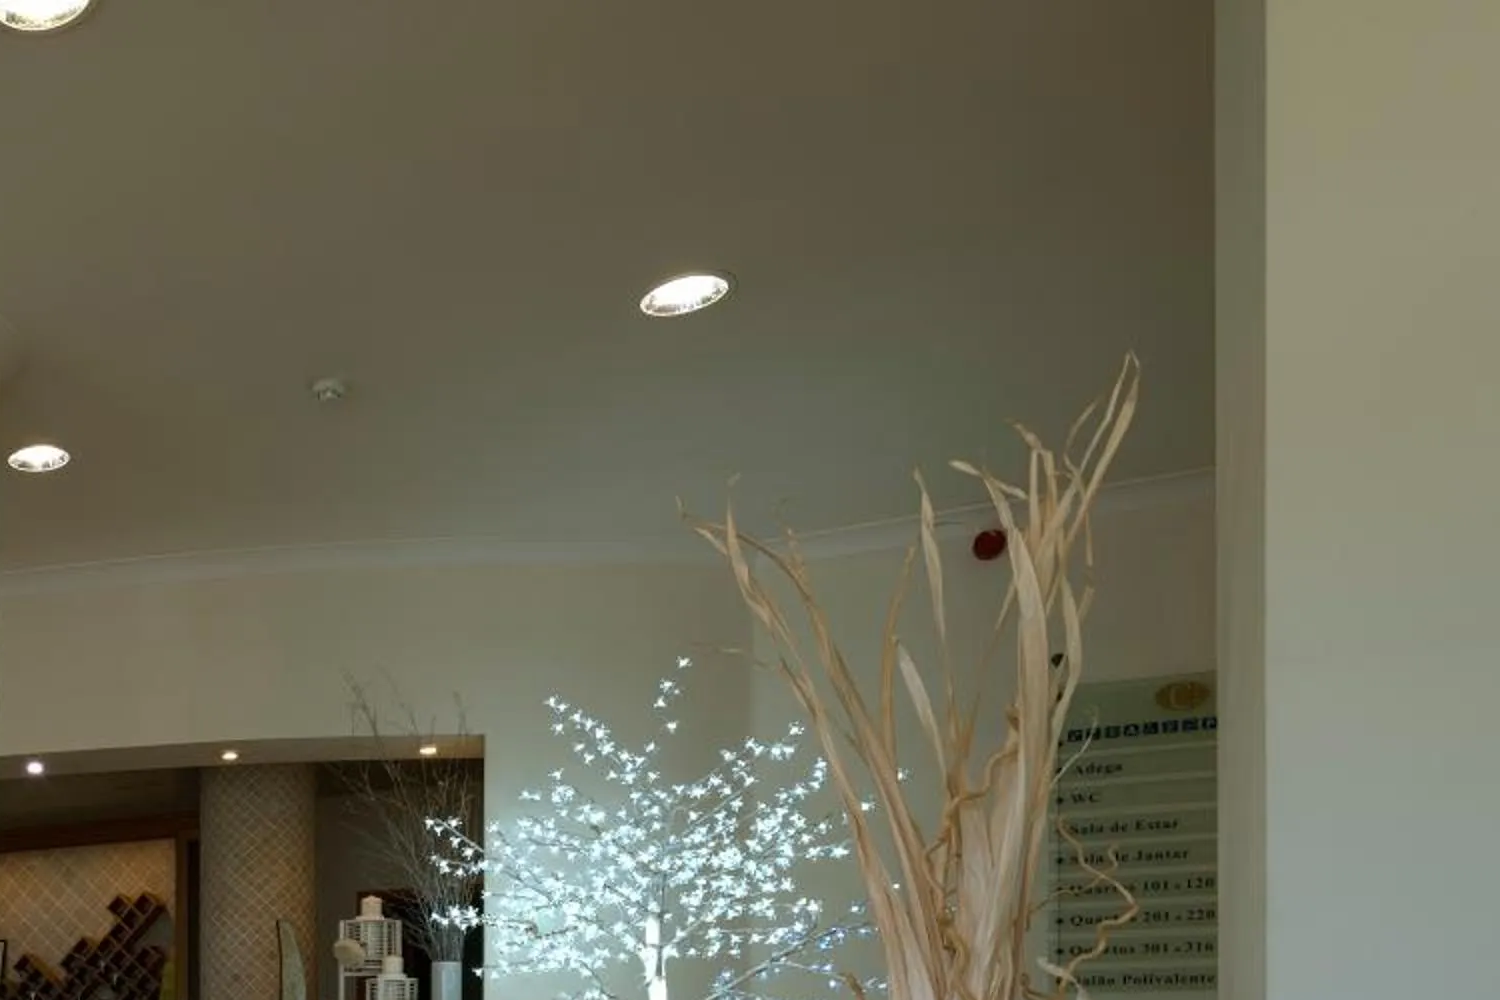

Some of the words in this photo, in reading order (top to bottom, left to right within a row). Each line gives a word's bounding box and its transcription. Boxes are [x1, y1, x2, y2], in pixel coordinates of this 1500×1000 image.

[1074, 761, 1123, 776] Adega
[1071, 792, 1100, 804] WC
[1069, 822, 1104, 835] Sala
[1109, 821, 1129, 833] de
[1135, 818, 1179, 831] Estar
[1136, 848, 1189, 861] Jantar
[1143, 880, 1169, 892] 101
[1143, 910, 1170, 923] 201
[1187, 907, 1215, 921] 220
[1122, 973, 1215, 985] Polivalente
